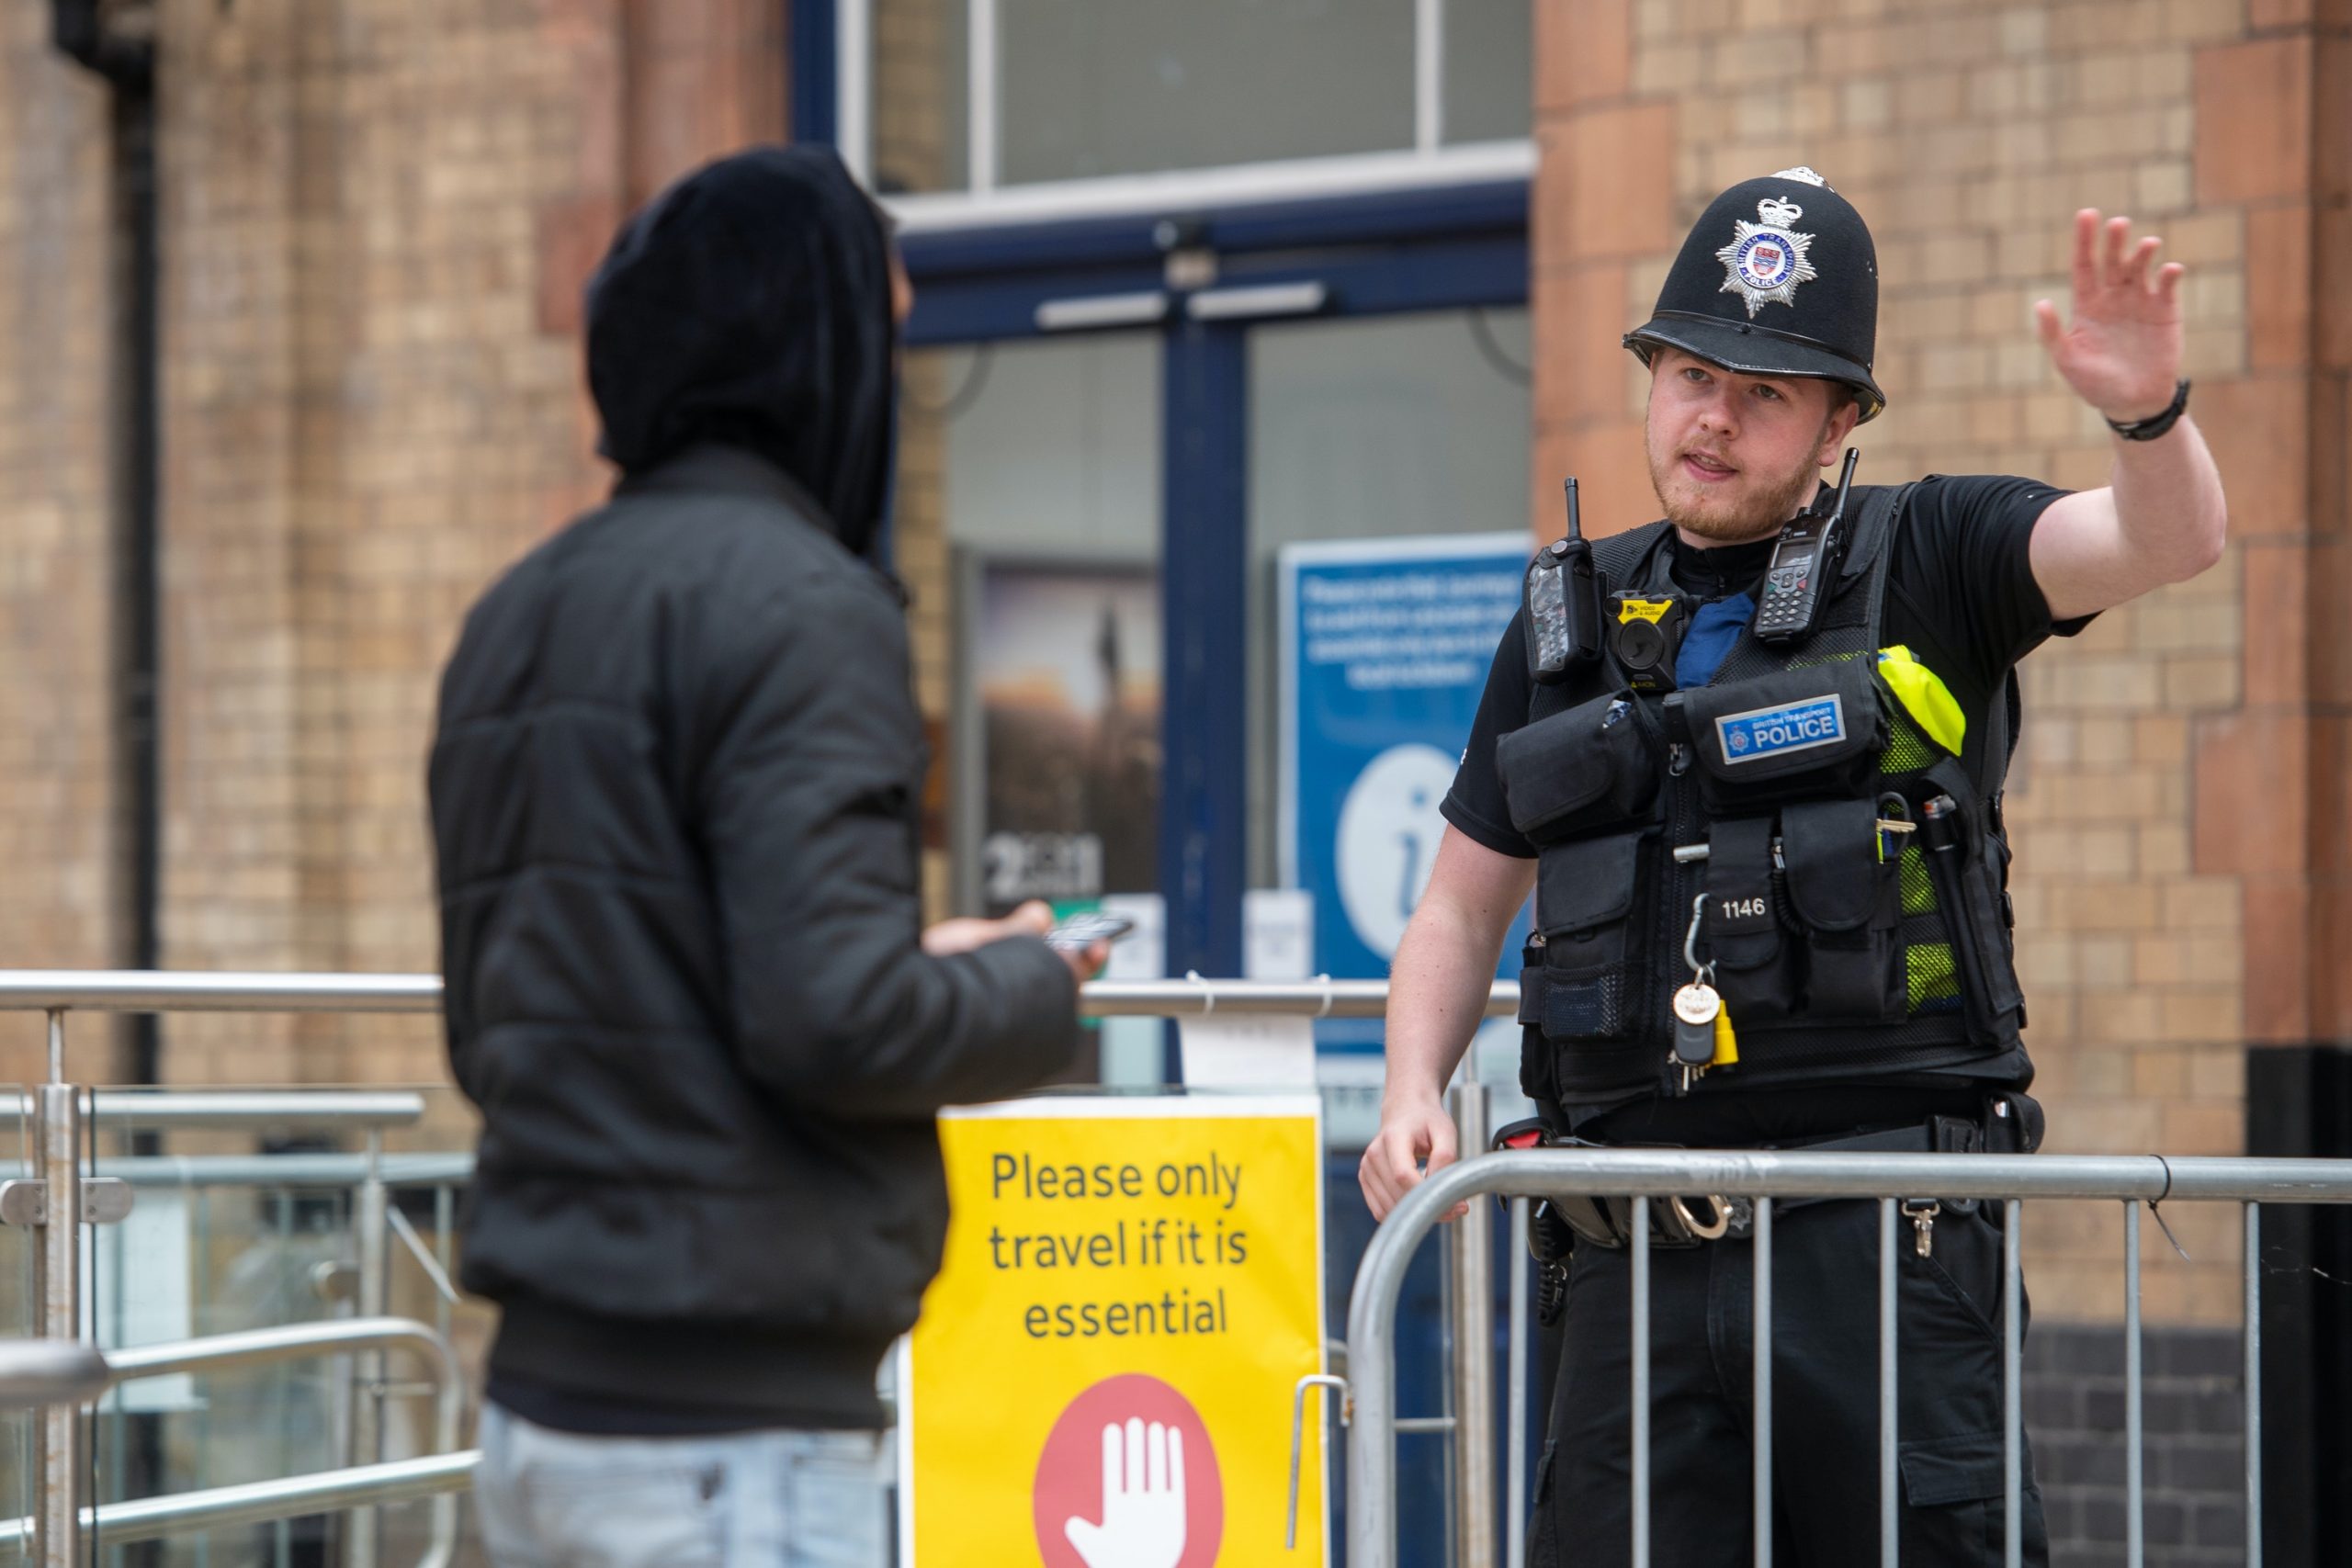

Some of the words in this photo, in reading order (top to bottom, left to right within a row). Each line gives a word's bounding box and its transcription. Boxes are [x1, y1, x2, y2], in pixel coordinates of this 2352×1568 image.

[1737, 235, 1758, 267] BRITISH
[1744, 272, 1778, 286] POLICE
[1752, 716, 1784, 730] BRITISH
[1783, 706, 1831, 722] TRANSPORT
[1753, 716, 1835, 749] POLICE
[1722, 897, 1766, 919] 1146
[992, 1153, 1143, 1199] Please
[1156, 1151, 1243, 1210] only
[989, 1221, 1126, 1269] travel
[1139, 1219, 1168, 1266] if
[1176, 1221, 1205, 1265] it
[1215, 1219, 1248, 1265] is
[1023, 1288, 1227, 1338] essential
